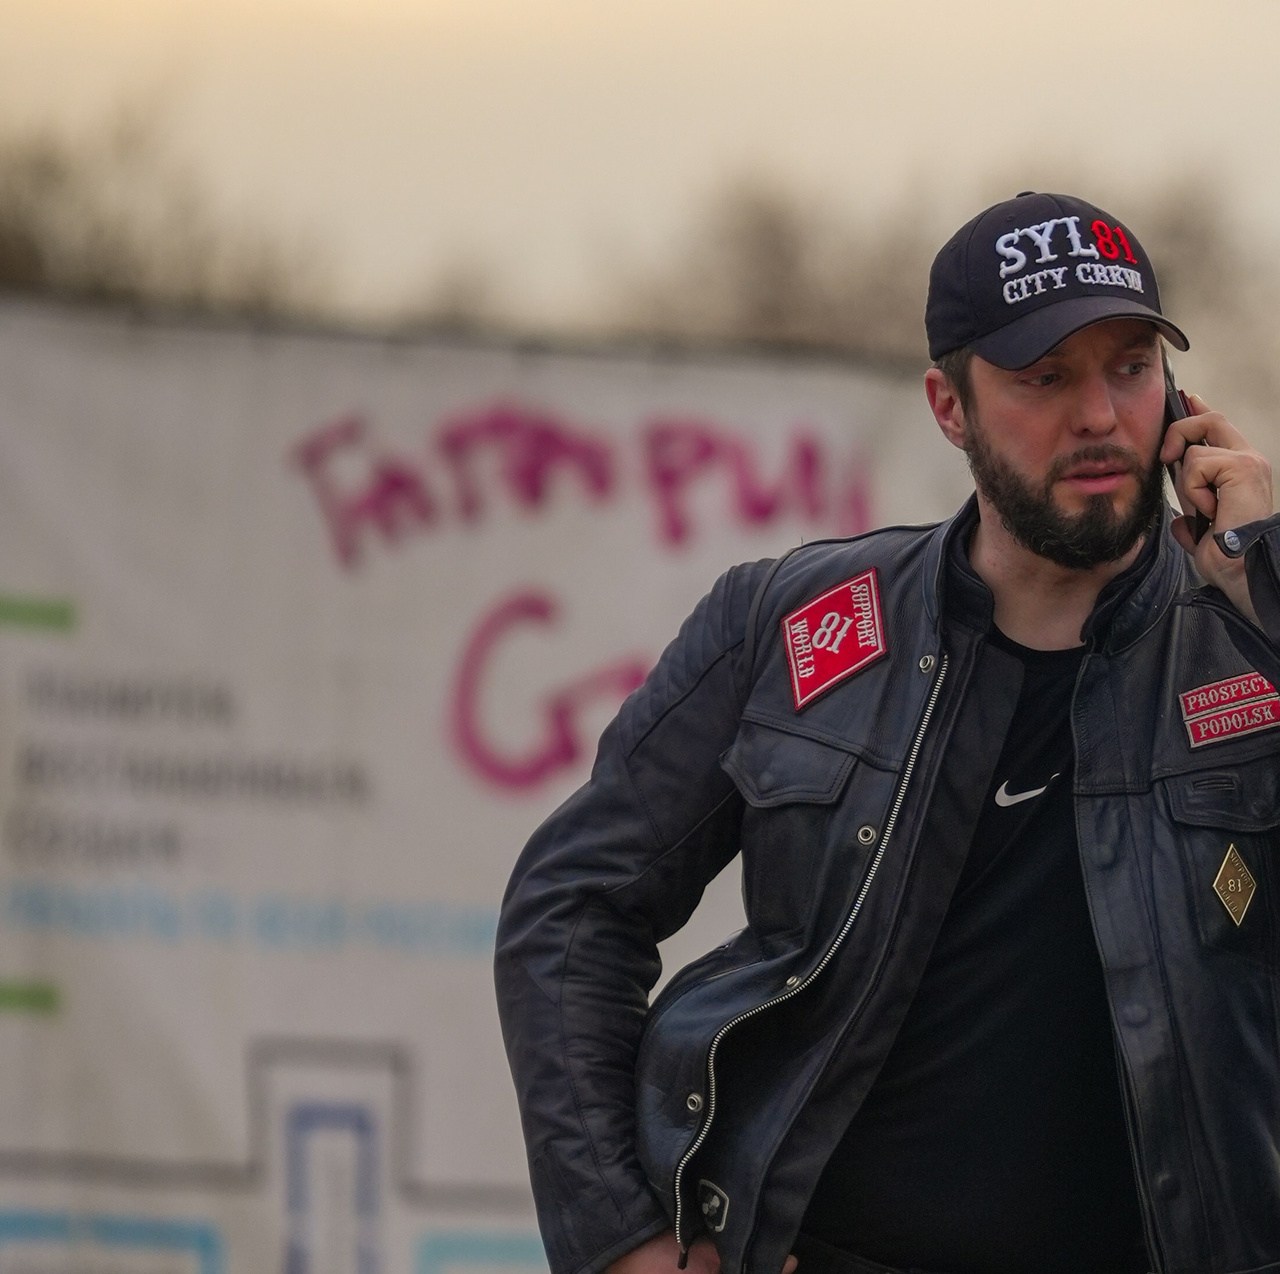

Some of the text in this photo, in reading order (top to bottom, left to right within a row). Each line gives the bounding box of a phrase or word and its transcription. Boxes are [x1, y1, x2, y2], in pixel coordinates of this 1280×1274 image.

[1002, 266, 1068, 305] CITY
[812, 611, 854, 655] 81
[850, 583, 878, 649] SUPPORT
[790, 618, 816, 679] WORLD
[1186, 676, 1271, 712] PROSPECT
[1197, 704, 1275, 739] PODOLSK
[1227, 878, 1242, 893] 81
